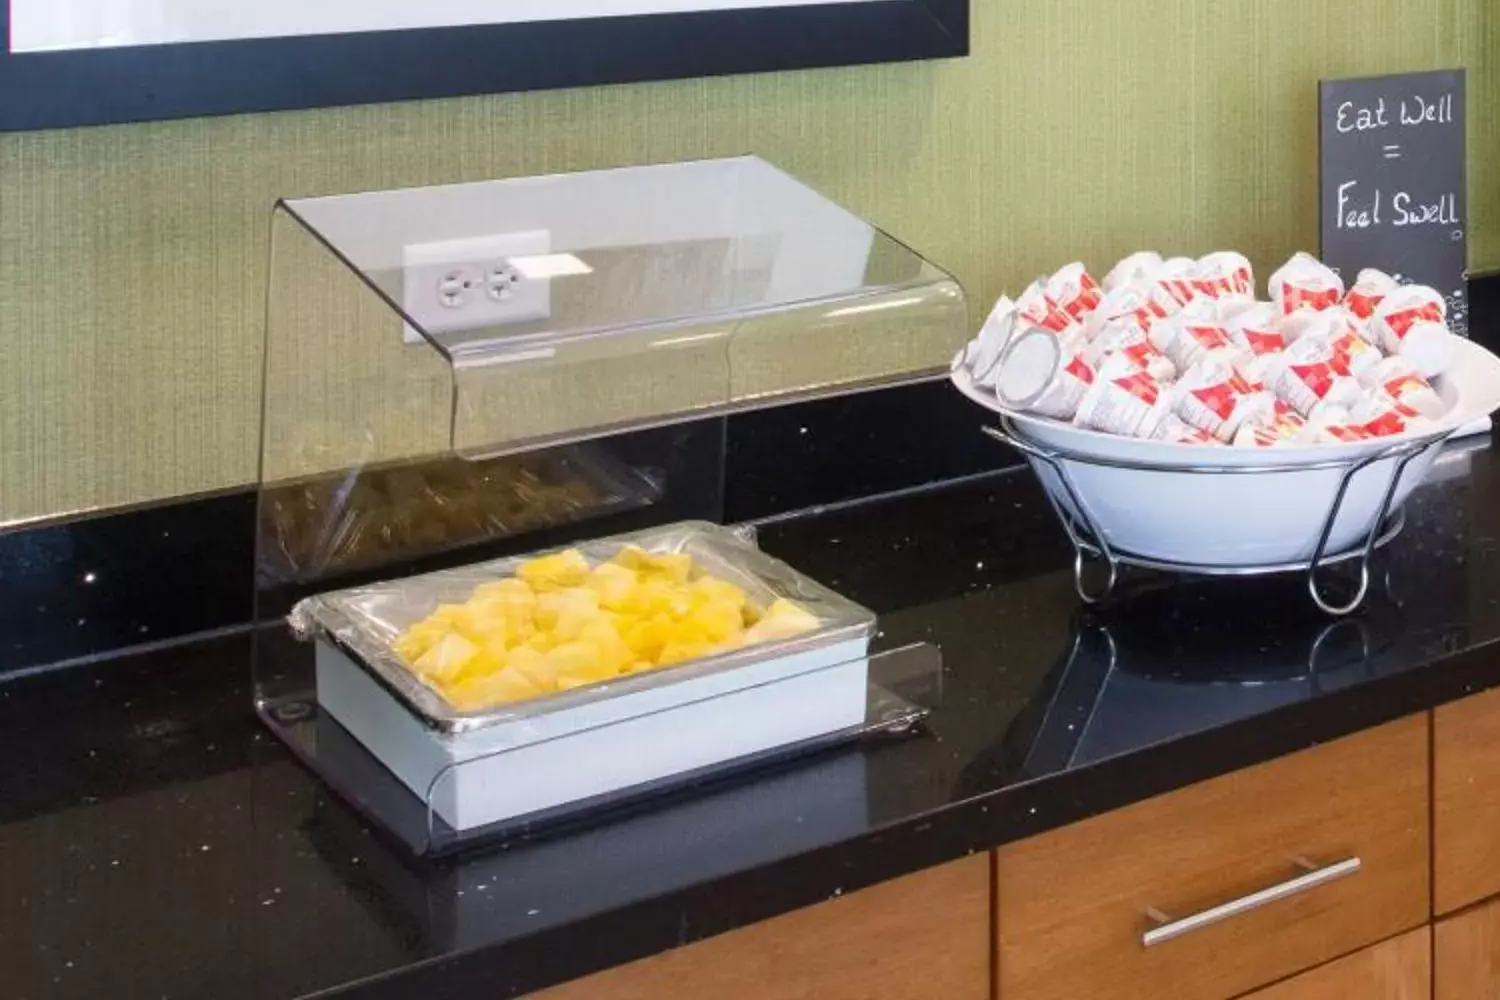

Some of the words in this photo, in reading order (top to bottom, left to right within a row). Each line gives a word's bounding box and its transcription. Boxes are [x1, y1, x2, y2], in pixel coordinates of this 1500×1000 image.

[1336, 98, 1389, 133] Eat
[1400, 94, 1453, 125] Well
[1336, 179, 1381, 229] Feel
[1393, 190, 1459, 227] Swell
